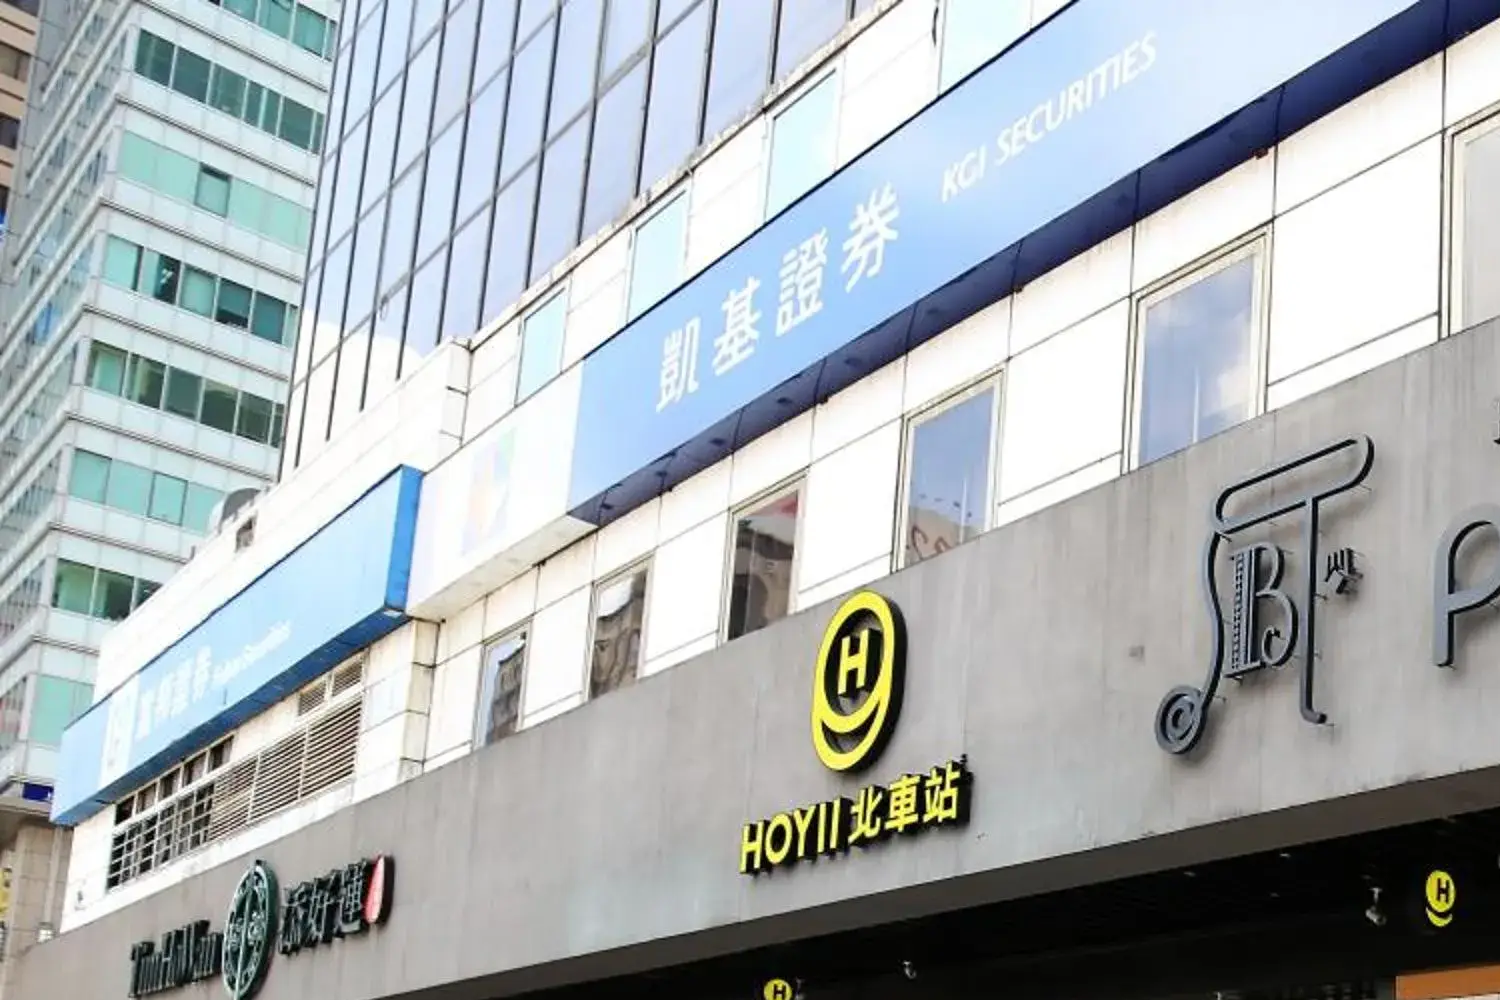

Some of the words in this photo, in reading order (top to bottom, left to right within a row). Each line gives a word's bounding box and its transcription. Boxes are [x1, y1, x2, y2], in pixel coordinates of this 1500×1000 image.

[941, 151, 987, 203] KGI
[994, 31, 1158, 168] SECURITIES
[655, 183, 899, 413] 凱基證券
[740, 797, 848, 873] HOYII
[848, 760, 966, 846] 北車站
